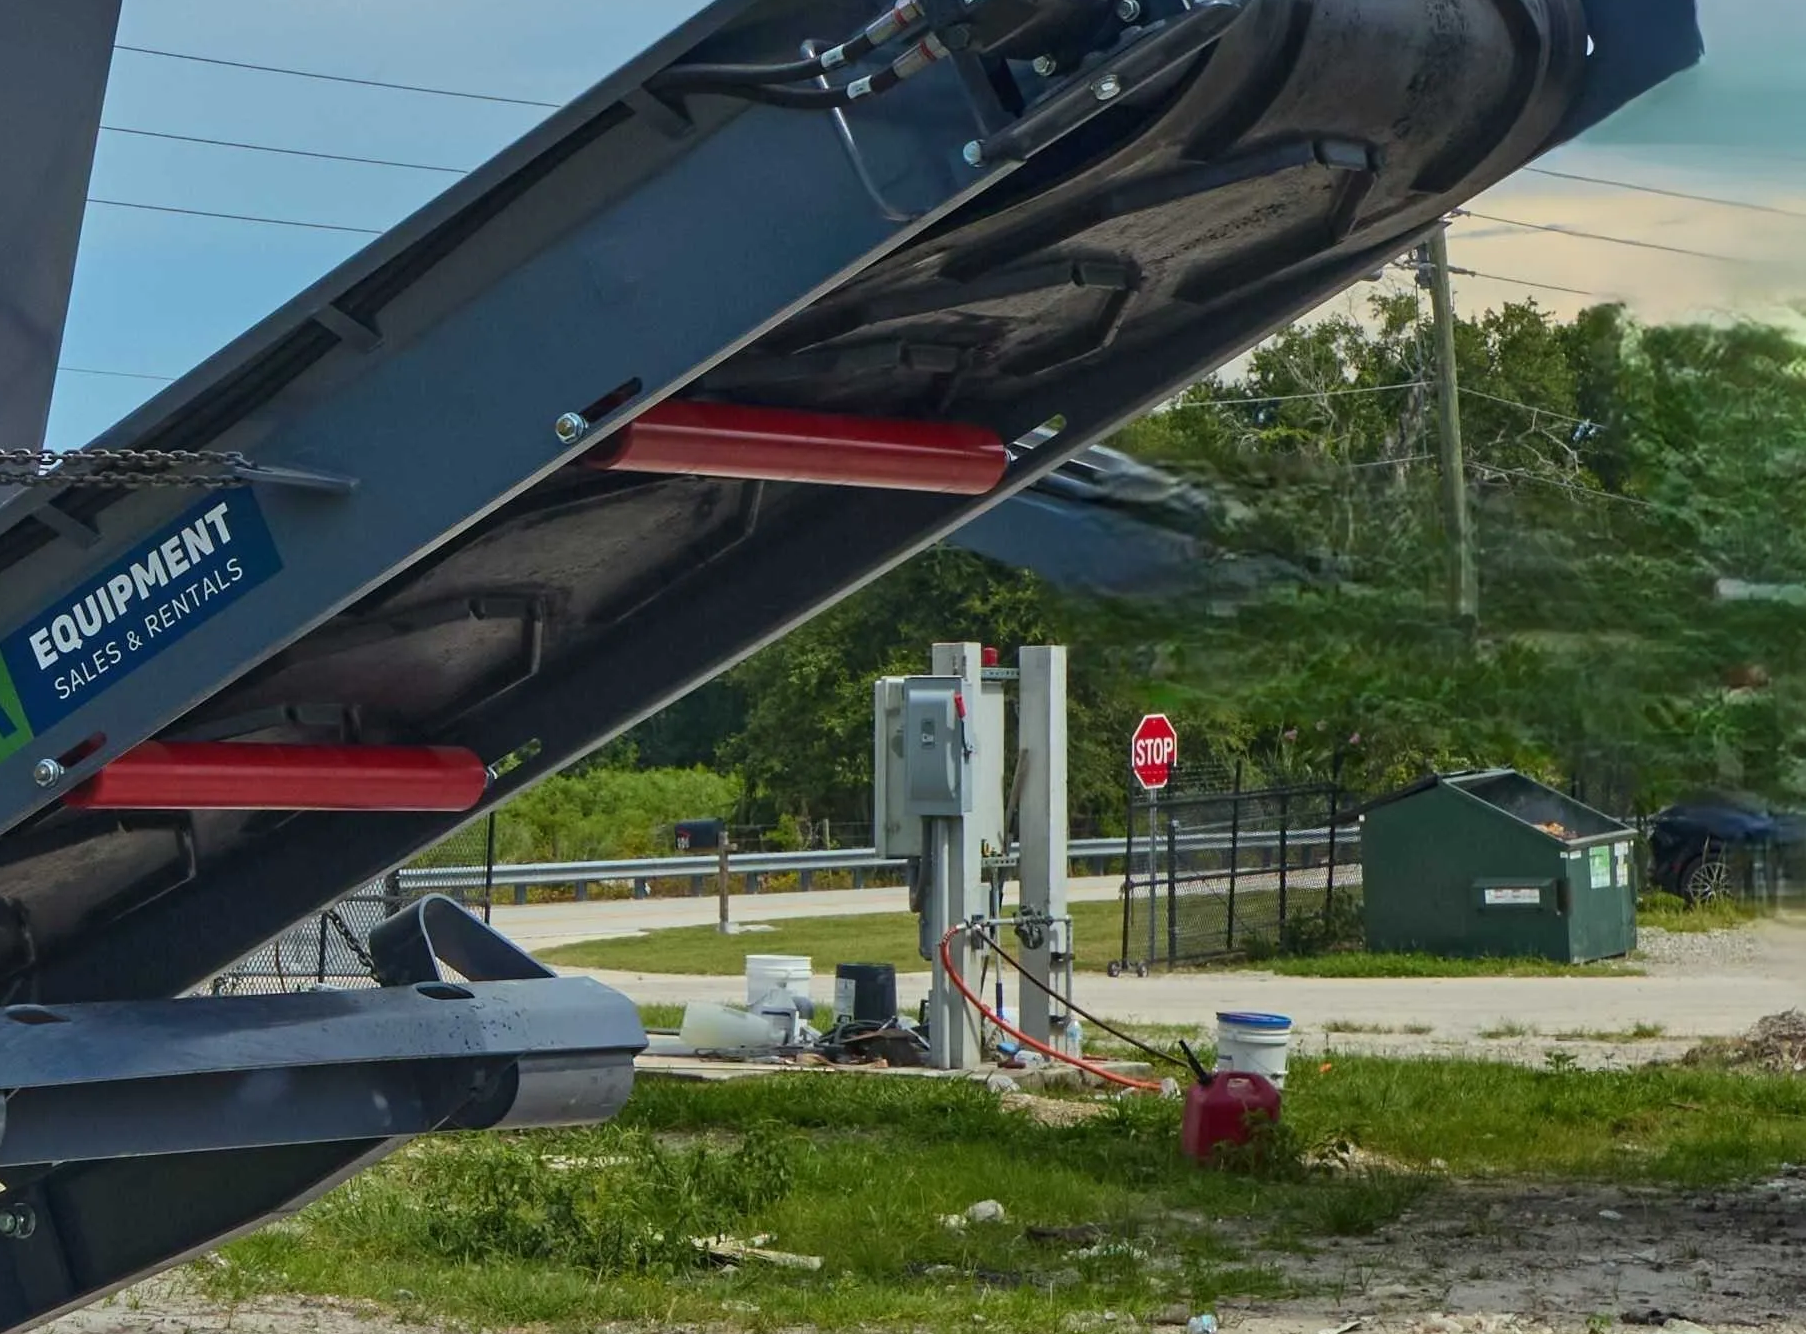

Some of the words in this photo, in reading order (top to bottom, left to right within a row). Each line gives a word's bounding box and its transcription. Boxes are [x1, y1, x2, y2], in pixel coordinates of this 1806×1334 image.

[28, 501, 233, 671] EQUIPMENT
[53, 641, 122, 700] SALES
[128, 630, 143, 652] &
[144, 558, 244, 638] RENTALS
[1135, 737, 1174, 767] STOP
